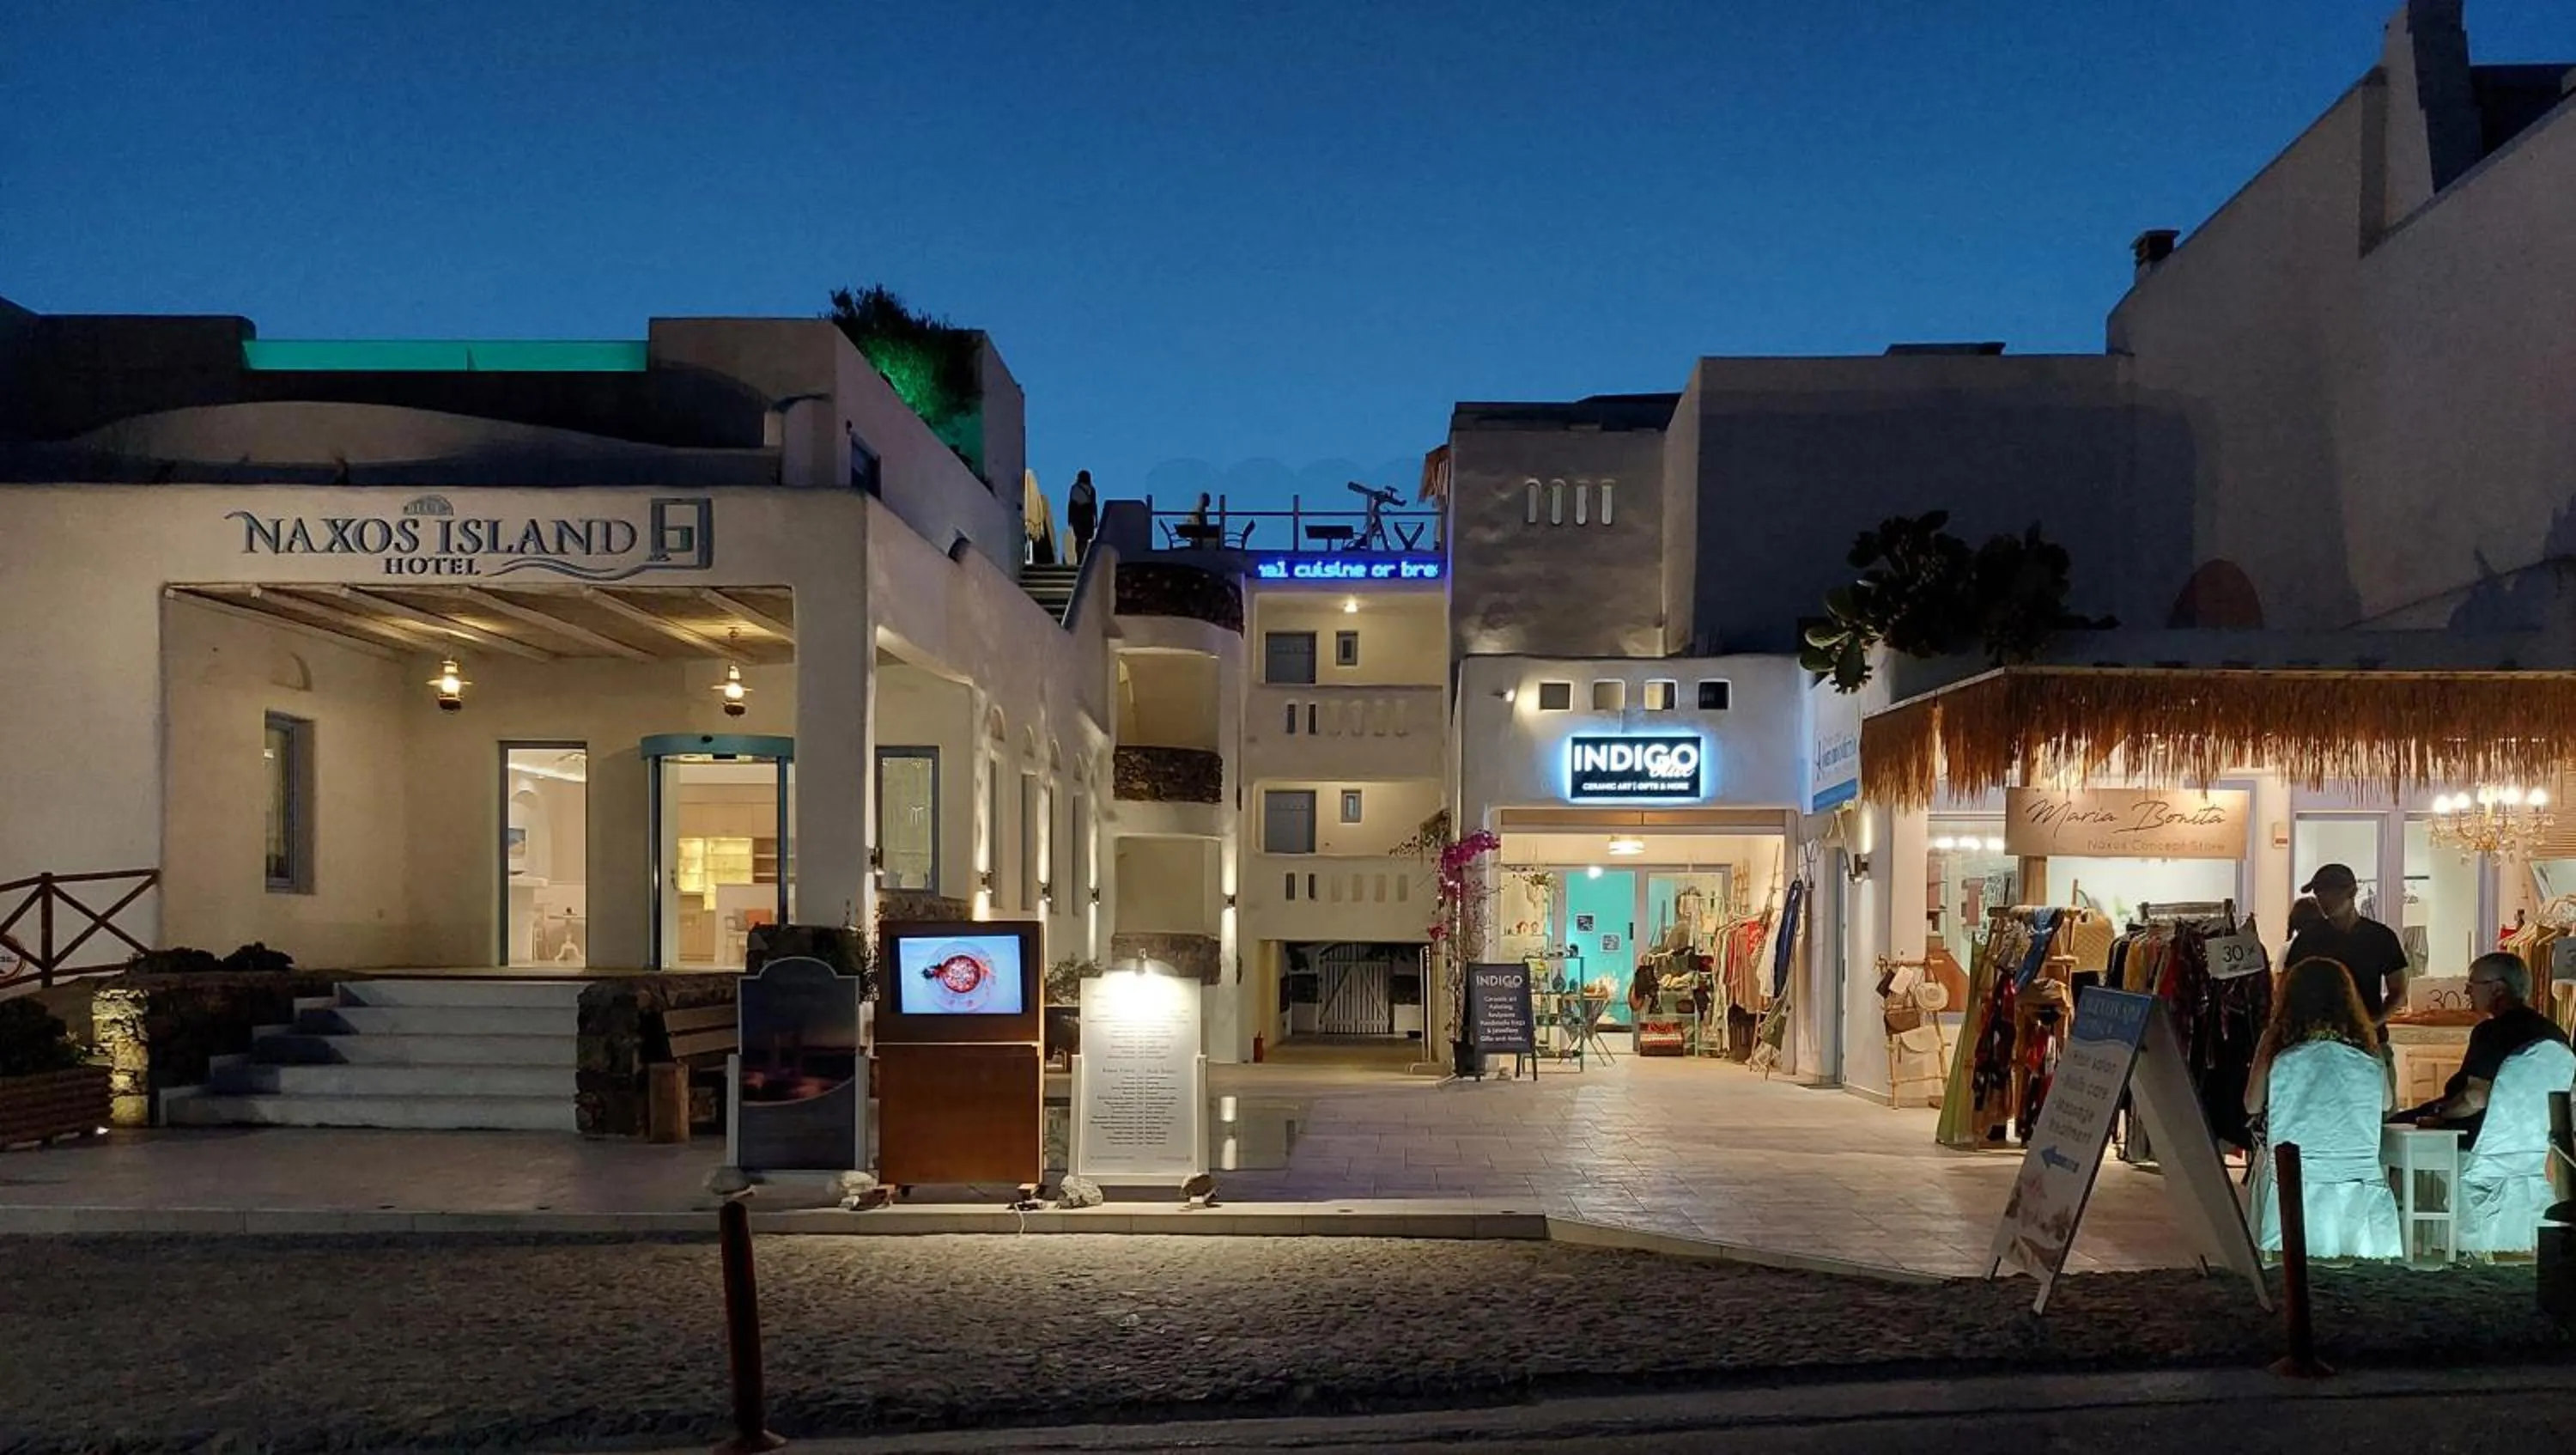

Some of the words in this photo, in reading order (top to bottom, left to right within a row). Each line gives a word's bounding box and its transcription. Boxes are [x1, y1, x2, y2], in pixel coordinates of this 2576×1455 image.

[224, 511, 420, 555] NAXOS
[435, 517, 637, 555] ISLAND
[383, 557, 482, 575] HOTEL
[1294, 561, 1367, 578] cuisine
[1371, 563, 1396, 578] or
[1574, 743, 1698, 772] INDIGO
[2026, 798, 2117, 838] Maria
[2111, 800, 2227, 834] Bonita
[2087, 839, 2127, 851] Naxos
[2131, 838, 2185, 853] Concept
[2190, 841, 2226, 852] Store
[1476, 975, 1522, 988] INDIGO
